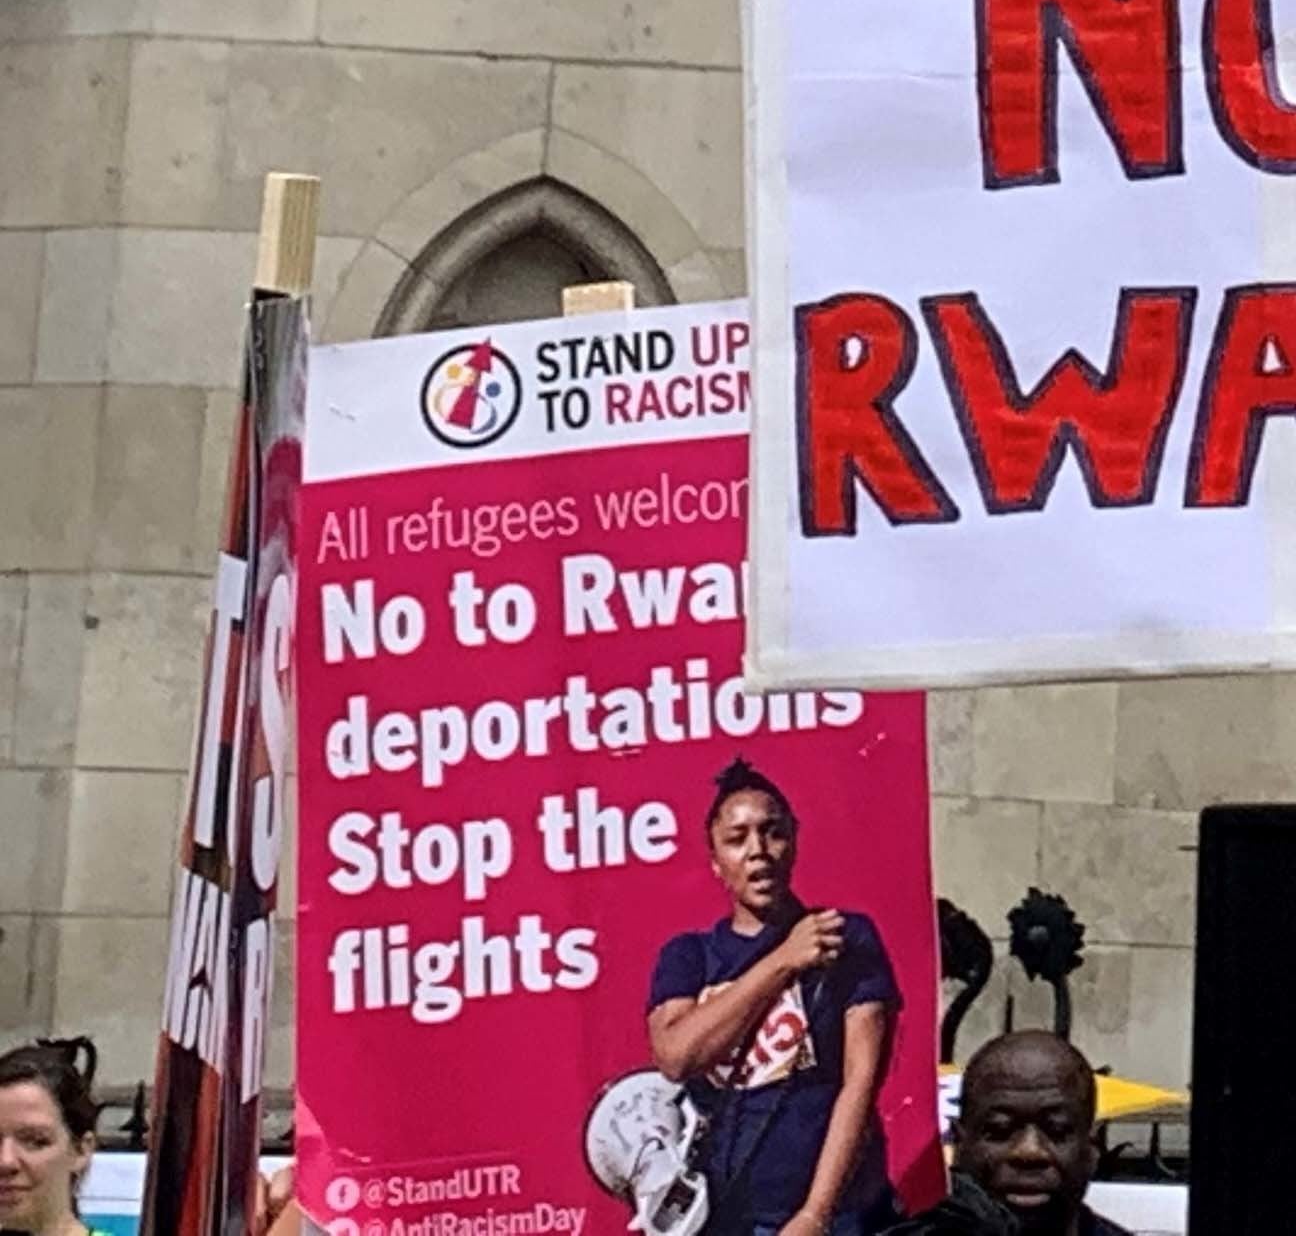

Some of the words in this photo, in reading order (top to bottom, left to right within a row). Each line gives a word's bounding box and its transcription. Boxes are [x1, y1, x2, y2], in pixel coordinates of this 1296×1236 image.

[536, 330, 675, 383] STAND
[690, 322, 750, 365] UP
[539, 387, 591, 432] TO
[317, 507, 368, 563] All
[387, 495, 580, 557] refugees
[321, 577, 425, 664] No
[449, 570, 536, 646] to
[561, 554, 749, 636] Rwa
[327, 810, 512, 901] Stop
[537, 787, 678, 873] the
[328, 914, 599, 1024] flights
[364, 1164, 521, 1209] @StandUTR
